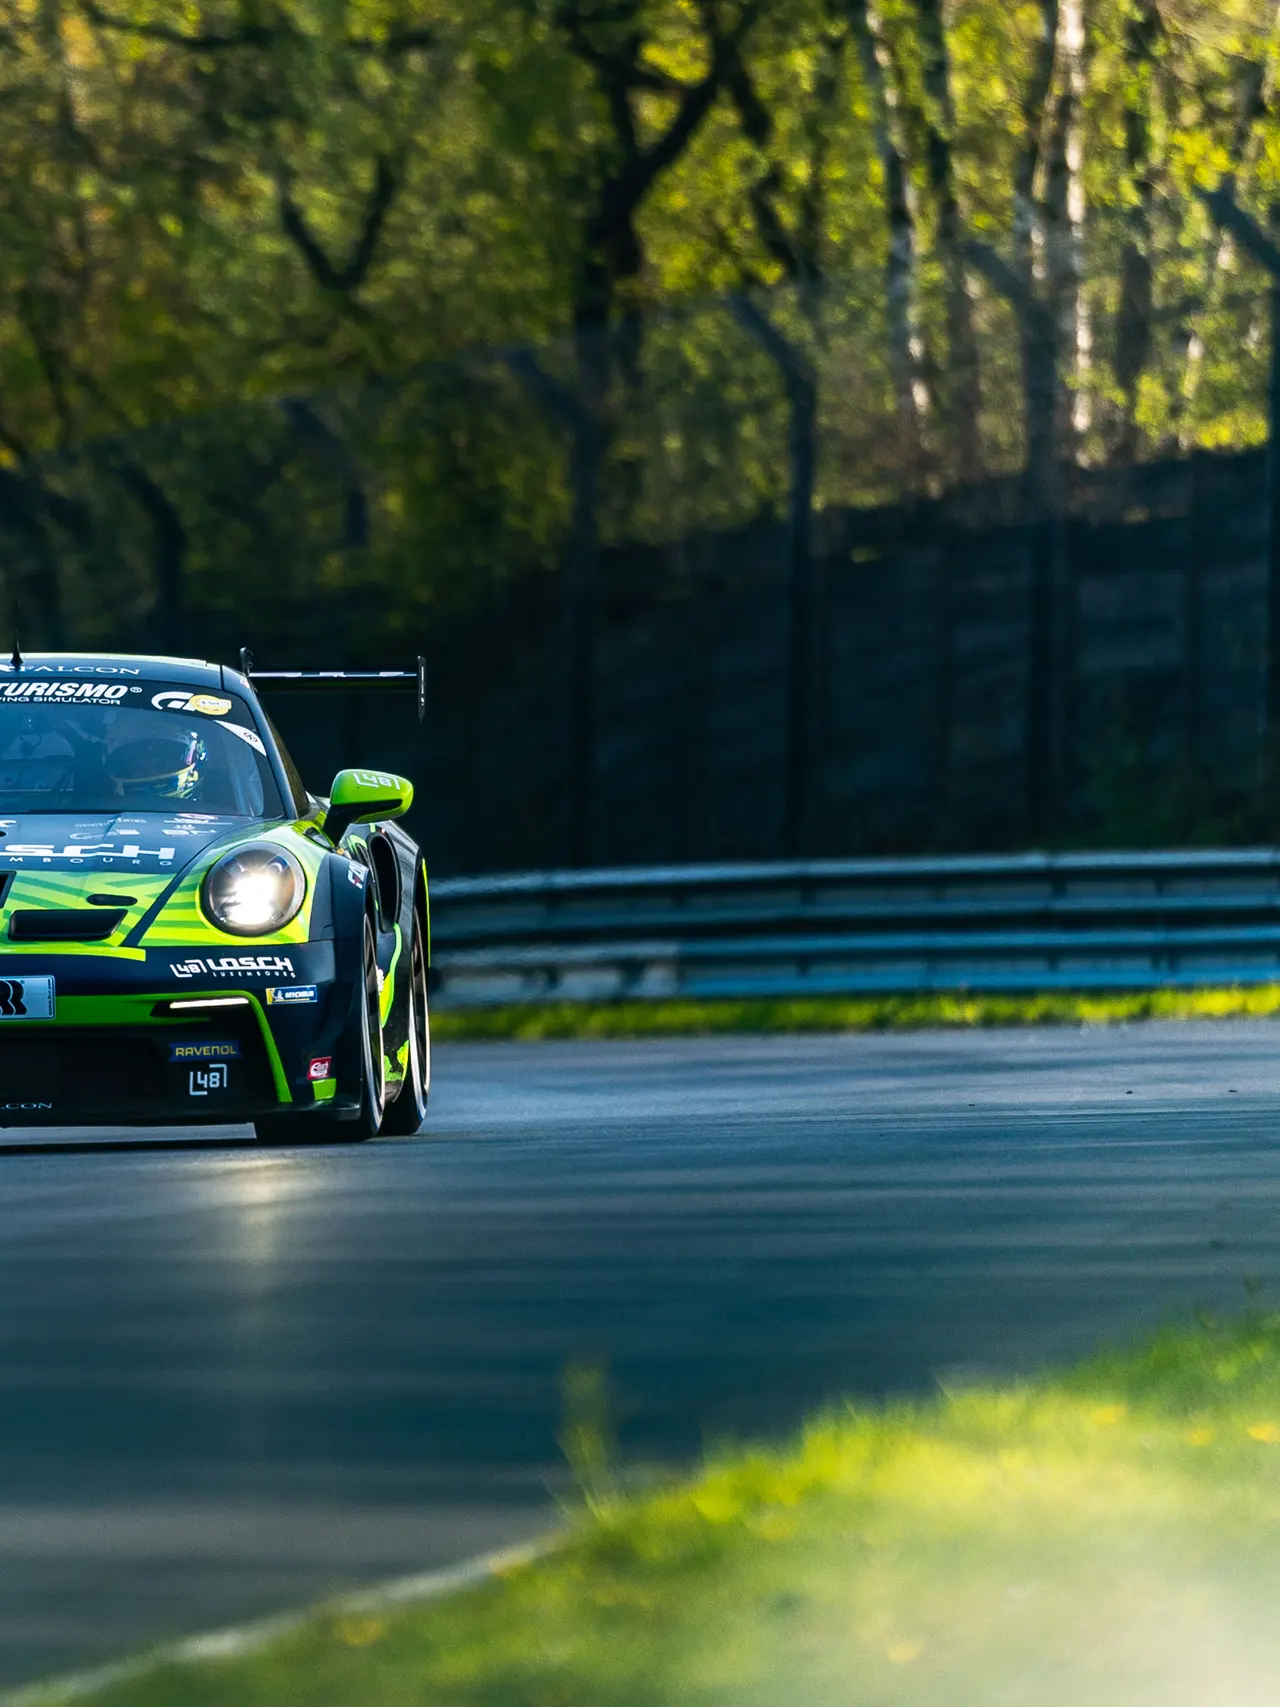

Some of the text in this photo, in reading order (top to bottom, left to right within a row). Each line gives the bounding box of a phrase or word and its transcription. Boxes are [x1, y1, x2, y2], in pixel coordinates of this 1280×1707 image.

[19, 665, 141, 675] FALCON
[33, 696, 121, 705] SIMULATOR
[206, 957, 294, 971] LOSCH
[175, 1045, 237, 1057] RAVENOL
